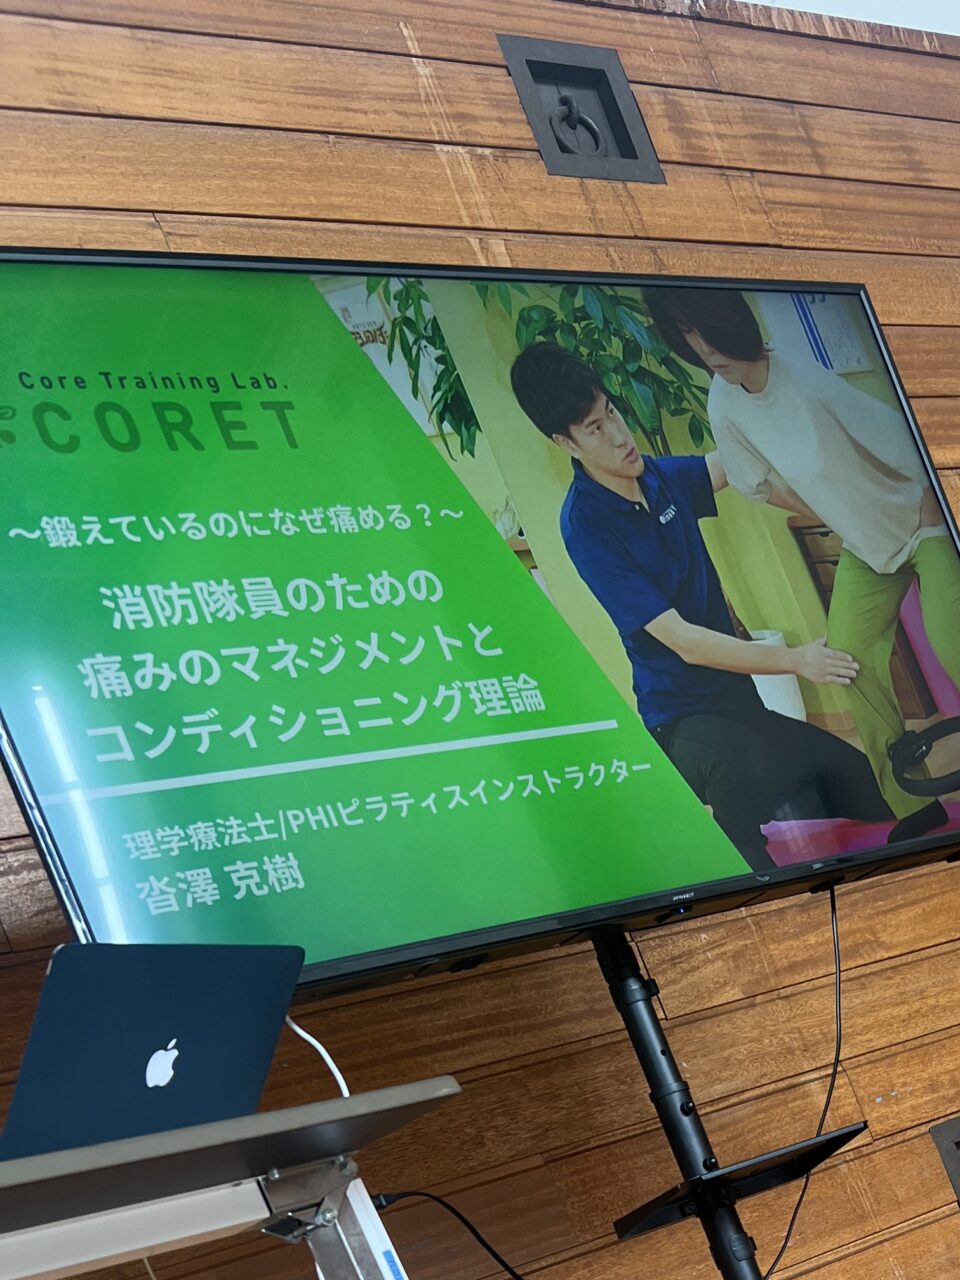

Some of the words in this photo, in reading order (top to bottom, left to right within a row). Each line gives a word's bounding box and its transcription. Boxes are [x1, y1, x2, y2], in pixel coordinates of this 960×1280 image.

[18, 371, 87, 390] Core
[99, 371, 221, 394] Training
[230, 372, 289, 390] Lab.
[32, 401, 300, 454] CORET
[100, 568, 444, 631] 消防隊員のための
[77, 620, 503, 700] 痛みのマネジメントと
[86, 672, 547, 764] コンディショニング理論
[122, 757, 652, 861] 理学療法士/PHIピラティスインストラクター
[223, 852, 305, 900] 克樹
